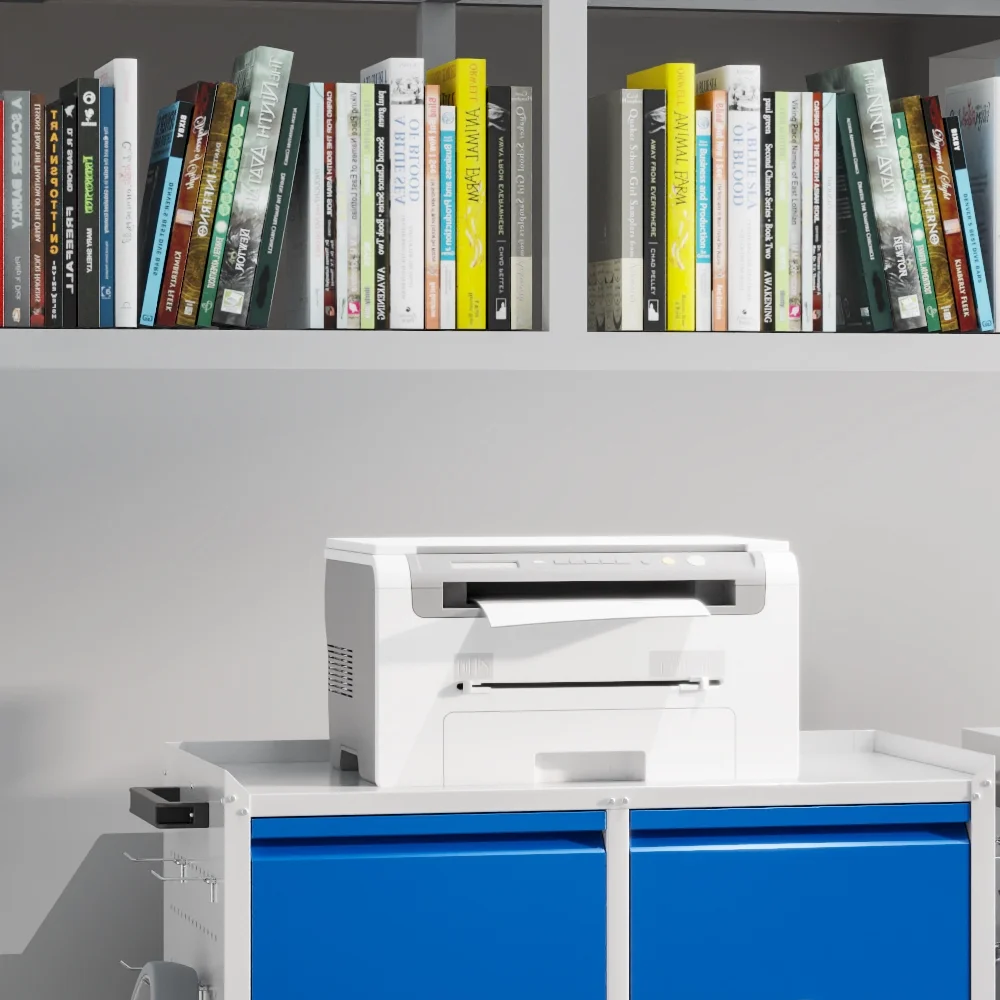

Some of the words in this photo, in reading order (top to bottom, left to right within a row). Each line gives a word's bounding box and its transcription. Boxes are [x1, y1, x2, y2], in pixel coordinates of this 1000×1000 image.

[762, 98, 773, 113] paul
[762, 114, 772, 134] green
[674, 111, 689, 165] ANIMAL
[765, 144, 773, 169] Second
[674, 170, 689, 206] FARM
[733, 150, 744, 206] BLOOD
[765, 169, 773, 196] Chance
[765, 197, 773, 218] Series
[765, 223, 773, 242] Book
[765, 242, 773, 259] Two
[893, 236, 907, 279] NEWTON
[764, 271, 772, 323] AWAKENING
[954, 259, 966, 294] KIMBERLY
[961, 296, 970, 318] FLEEK
